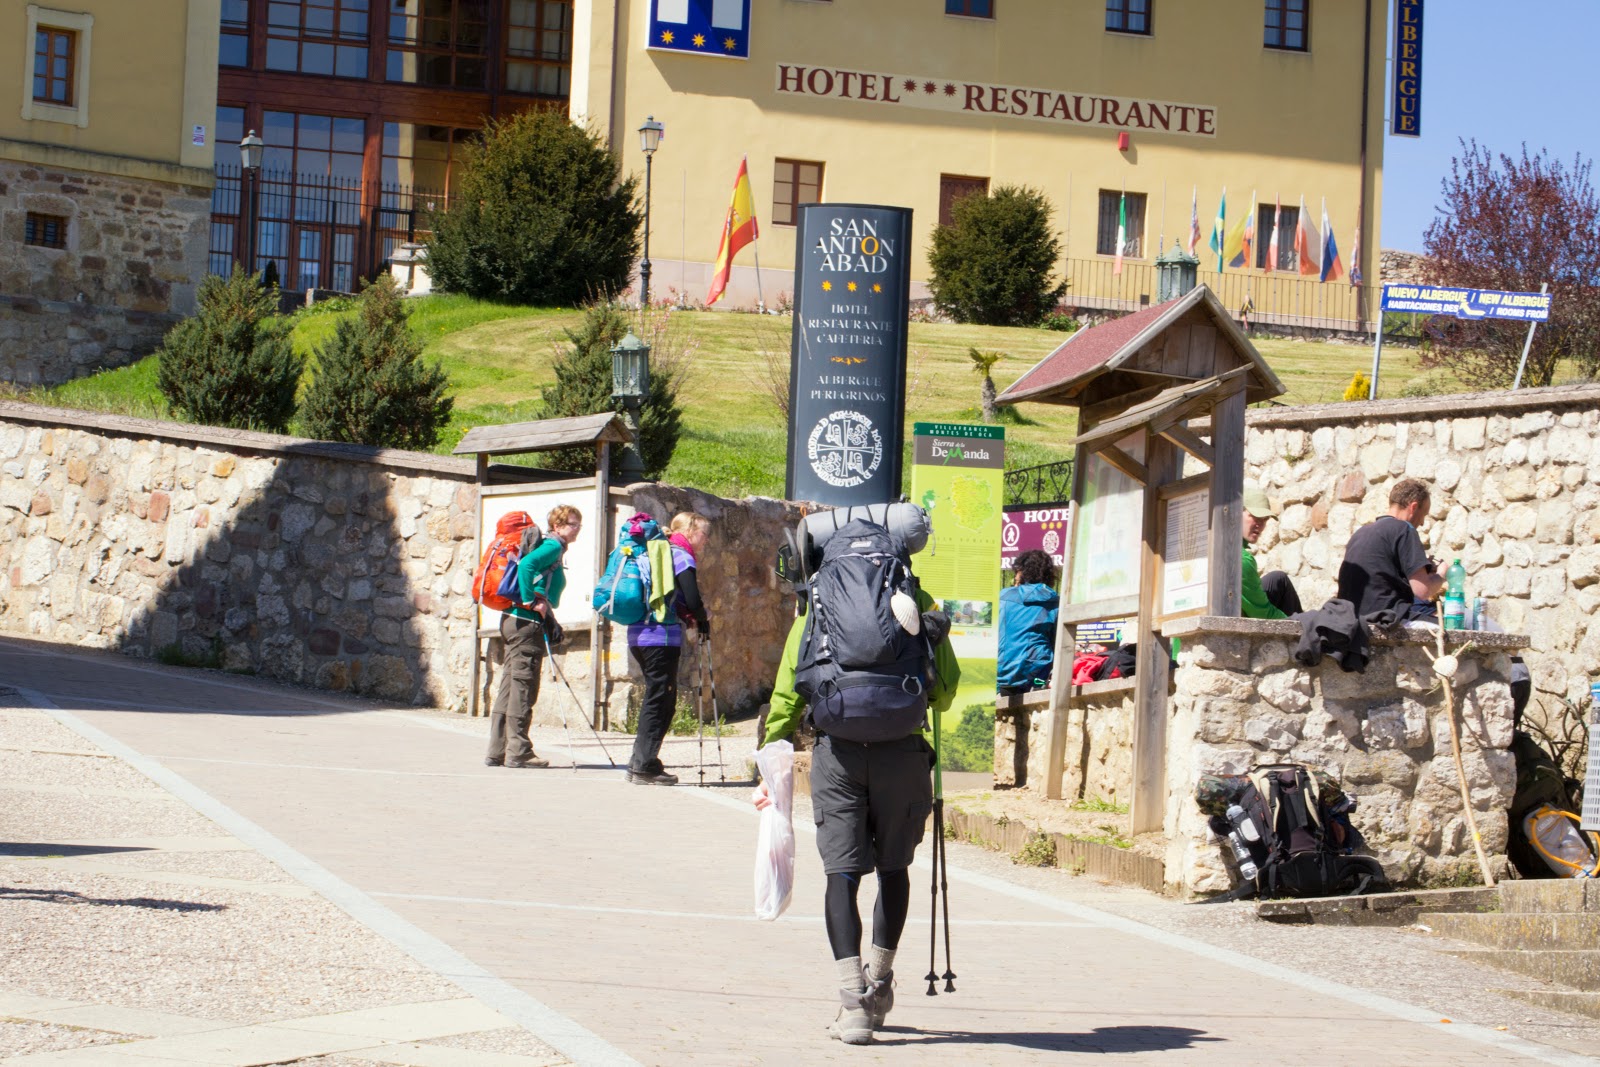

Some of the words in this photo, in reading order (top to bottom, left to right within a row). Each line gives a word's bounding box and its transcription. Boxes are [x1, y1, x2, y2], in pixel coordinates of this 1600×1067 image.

[777, 65, 900, 103] HOTEL
[962, 84, 1216, 135] RESTAURANTE
[830, 218, 878, 237] SAN
[813, 236, 895, 257] ANTON
[820, 254, 888, 273] ABAD
[1387, 286, 1419, 299] NUEVO
[1419, 289, 1468, 302] ALBERGUE
[1478, 293, 1502, 305] NEW
[1501, 294, 1551, 308] ALBERGUE
[831, 304, 871, 315] HOTEL
[1387, 300, 1443, 312] HABITACIONES
[1443, 304, 1459, 313] DES
[1496, 308, 1525, 317] ROOMS
[1526, 309, 1548, 319] FROM
[808, 319, 894, 331] RESTAURANTE
[816, 375, 882, 387] ALBERGUE
[810, 390, 886, 402] PEREGRINOS
[932, 438, 955, 447] Sierra
[1024, 508, 1069, 523] HOTE
